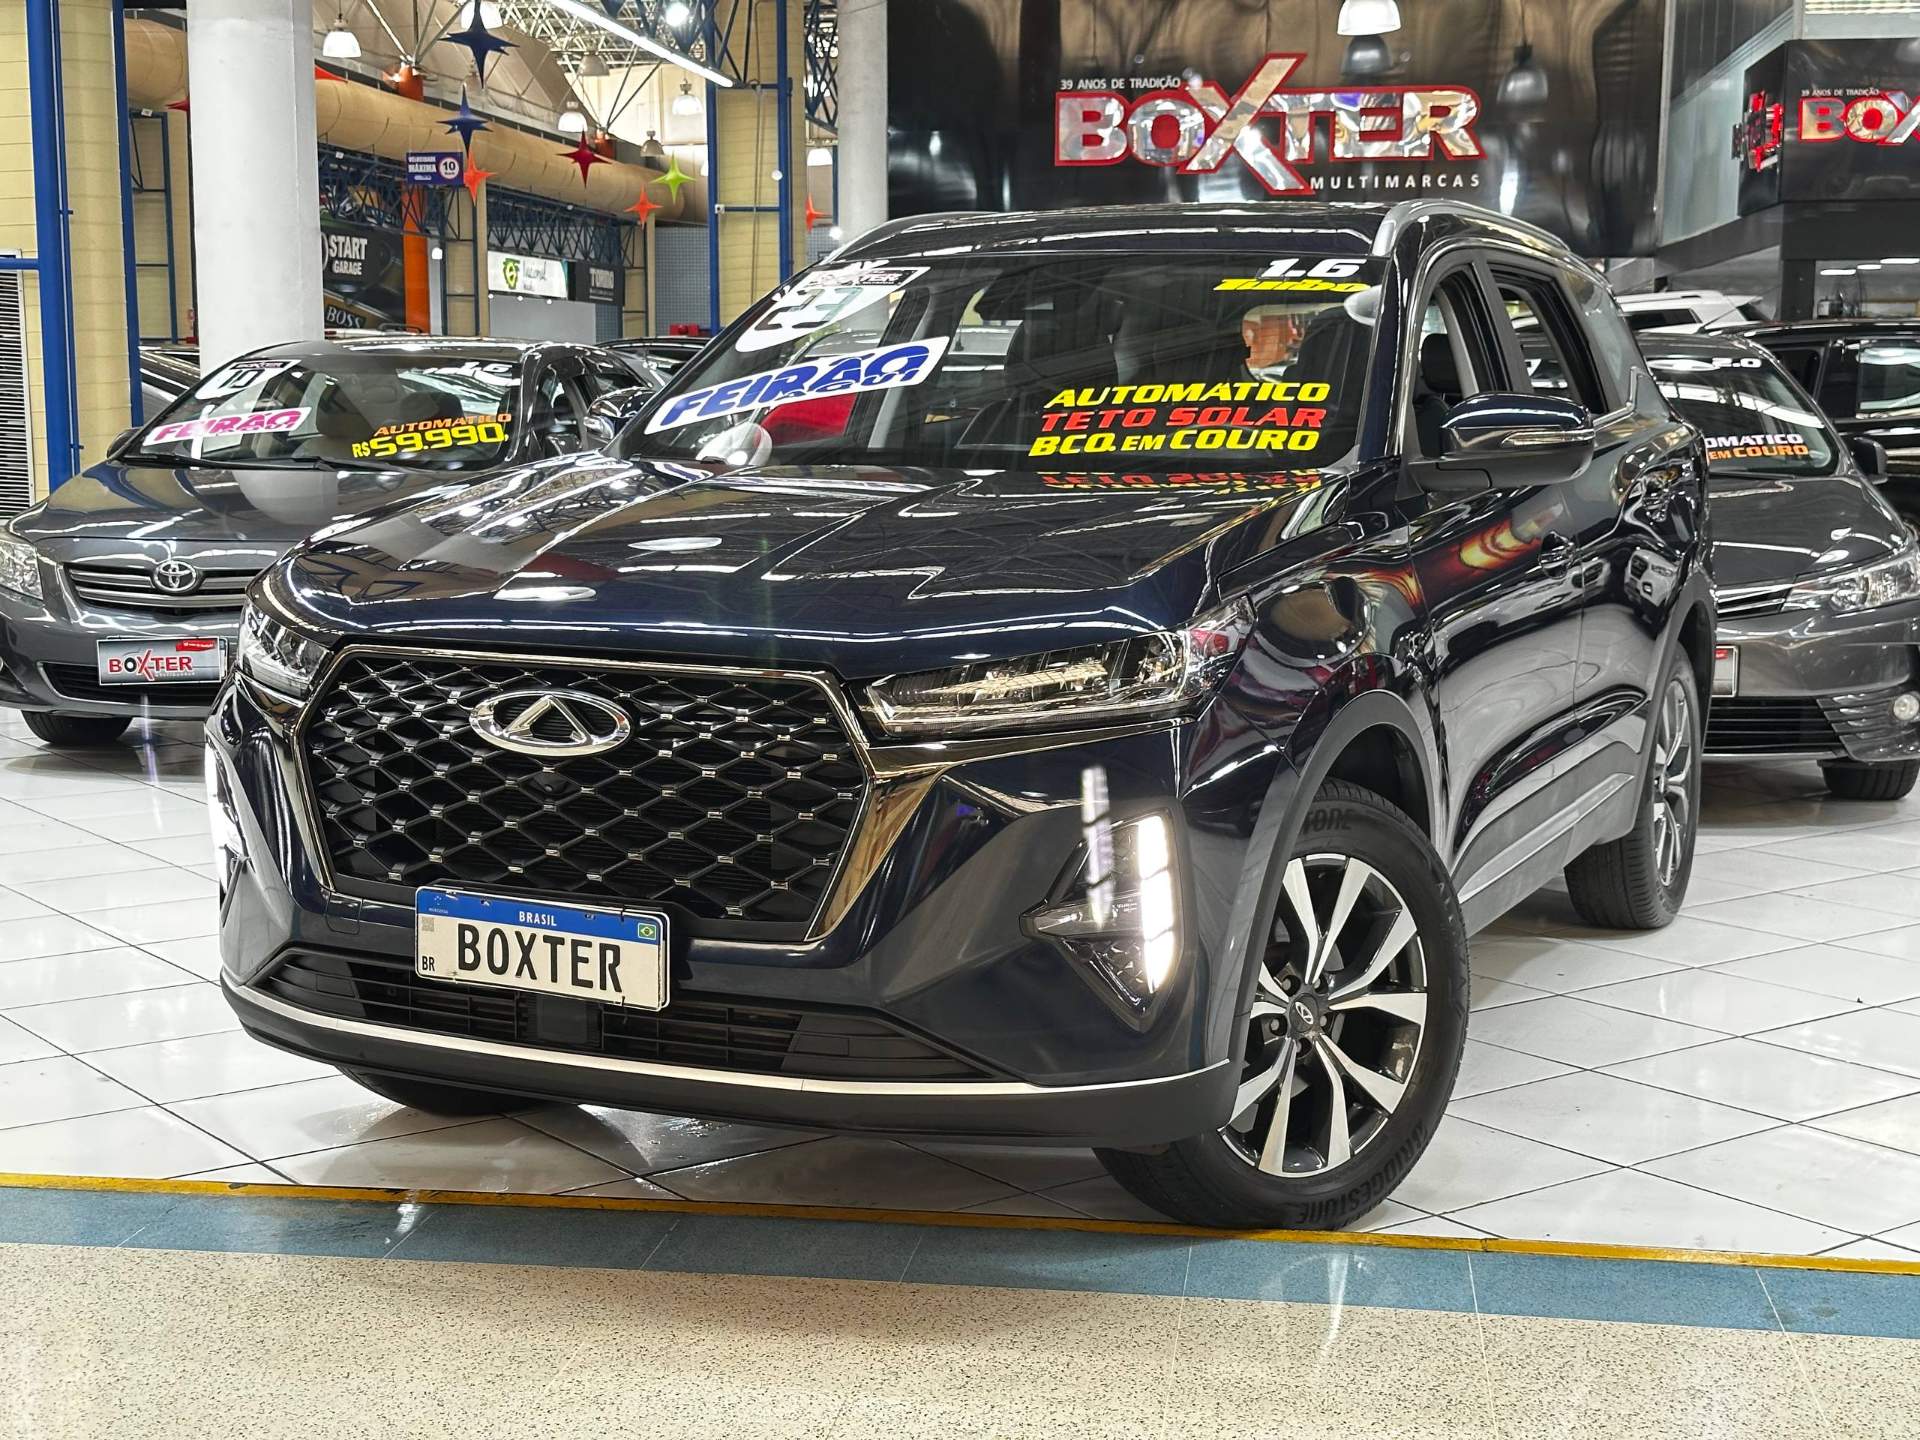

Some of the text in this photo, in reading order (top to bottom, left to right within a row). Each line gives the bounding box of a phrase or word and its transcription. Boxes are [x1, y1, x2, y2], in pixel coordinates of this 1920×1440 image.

[1060, 75, 1181, 91] 39 ANOS DE TRADIÇÃO
[1055, 52, 1487, 195] BOXTER
[442, 161, 456, 171] 10
[1309, 174, 1481, 191] MULTIMARCAS
[329, 235, 368, 260] START
[333, 260, 362, 275] GARAGE
[1260, 258, 1367, 278] 1.6
[1041, 406, 1327, 432] TETO SOLAR
[1120, 434, 1167, 451] EM
[1169, 429, 1320, 451] COURO
[1704, 433, 1804, 449] OMATICO
[1709, 445, 1809, 460] EM COURO
[107, 649, 193, 681] BOXTER
[519, 911, 557, 926] BRASIL
[422, 955, 435, 972] BR
[458, 923, 622, 993] BOXTER
